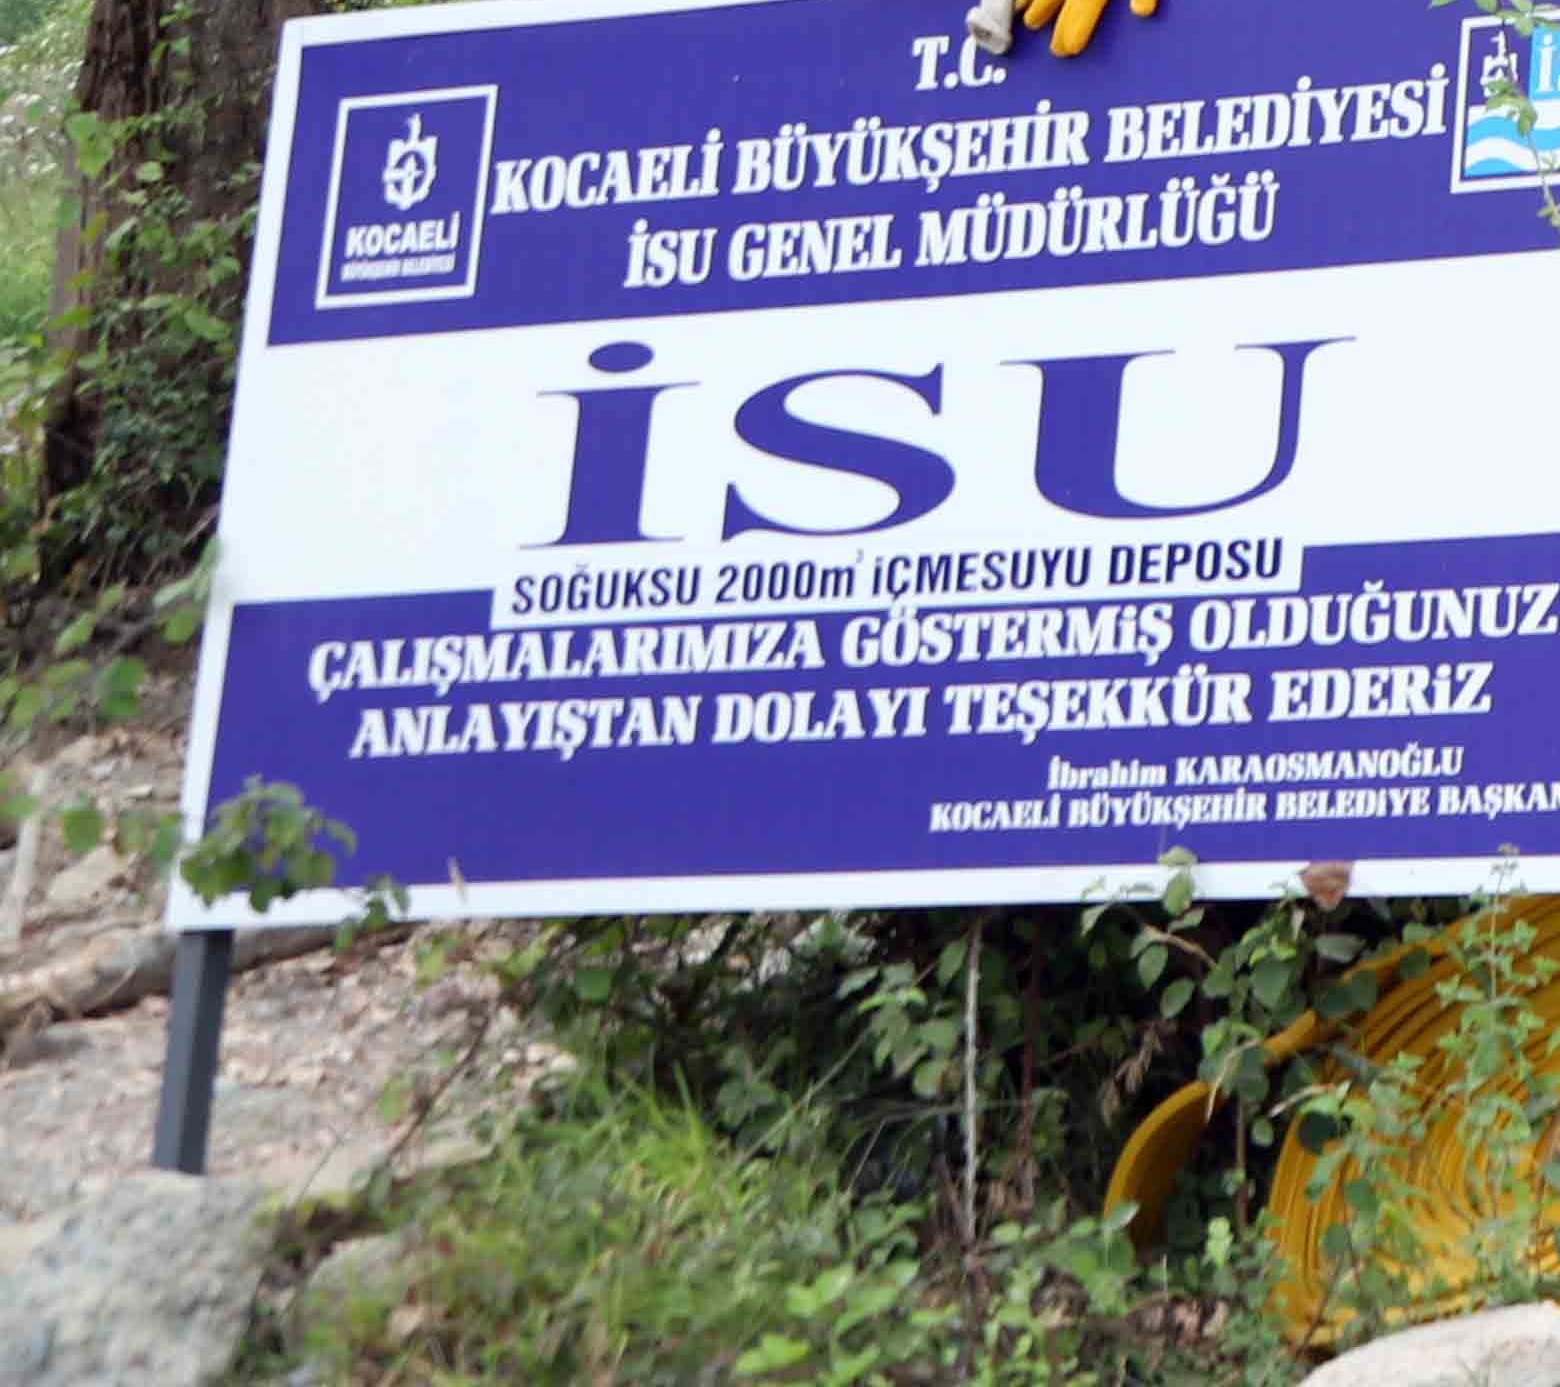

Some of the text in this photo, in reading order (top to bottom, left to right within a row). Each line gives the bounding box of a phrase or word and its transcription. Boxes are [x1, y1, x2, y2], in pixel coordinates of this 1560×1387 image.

[912, 35, 1007, 91] T.C.
[489, 63, 1449, 215] KOCAELİ BÜYÜKŞEHİR BELEDİYESİ
[623, 171, 1280, 289] İSU GENEL MÜDÜRLÜĞÜ
[518, 336, 1358, 550] İSU
[512, 562, 702, 614] SOĞUKSU
[1108, 538, 1284, 587] DEPOSU
[308, 620, 825, 702] ÇALIŞMALARIMIZA
[1189, 580, 1560, 652] OLDUĞUNUZ
[348, 694, 702, 762] ANLAYIŞTAN
[712, 684, 930, 745] DOLAYI
[943, 663, 1252, 745] TEŞEKKÜR
[930, 793, 1060, 832] KOCAELİ
[1068, 787, 1267, 831] BÜYÜKŞEHİR
[1048, 742, 1464, 790] İbrahim KARAOSMANOĞLU
